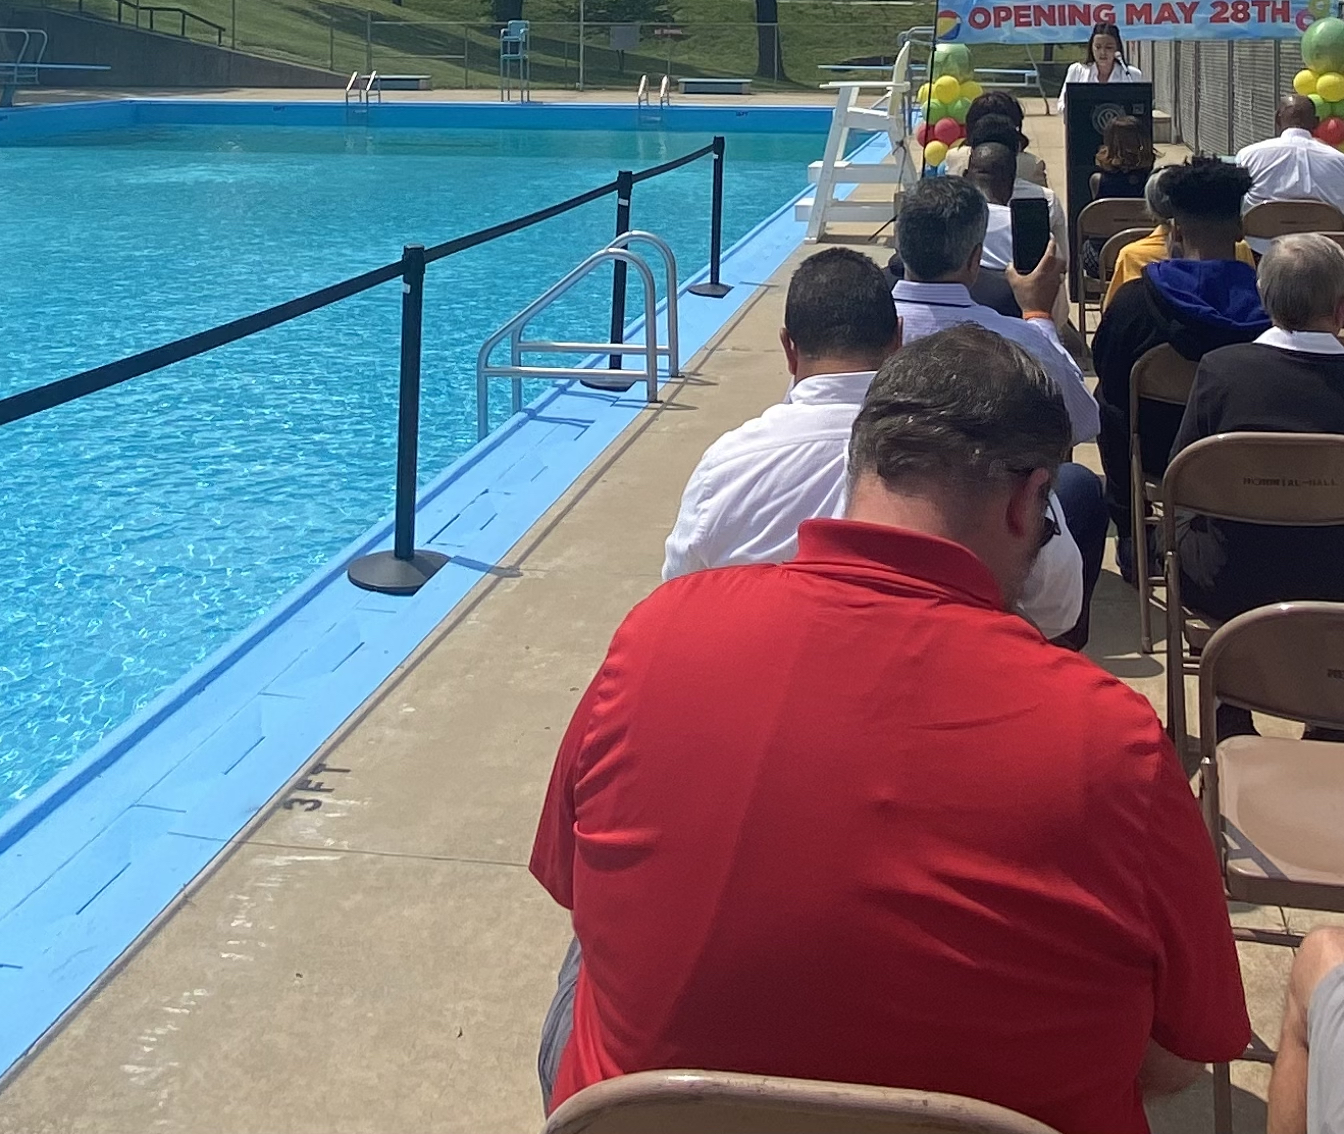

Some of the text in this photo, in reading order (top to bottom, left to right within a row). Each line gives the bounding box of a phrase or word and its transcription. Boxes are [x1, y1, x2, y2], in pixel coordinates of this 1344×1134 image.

[968, 0, 1290, 29] OPENING MAY 28TH
